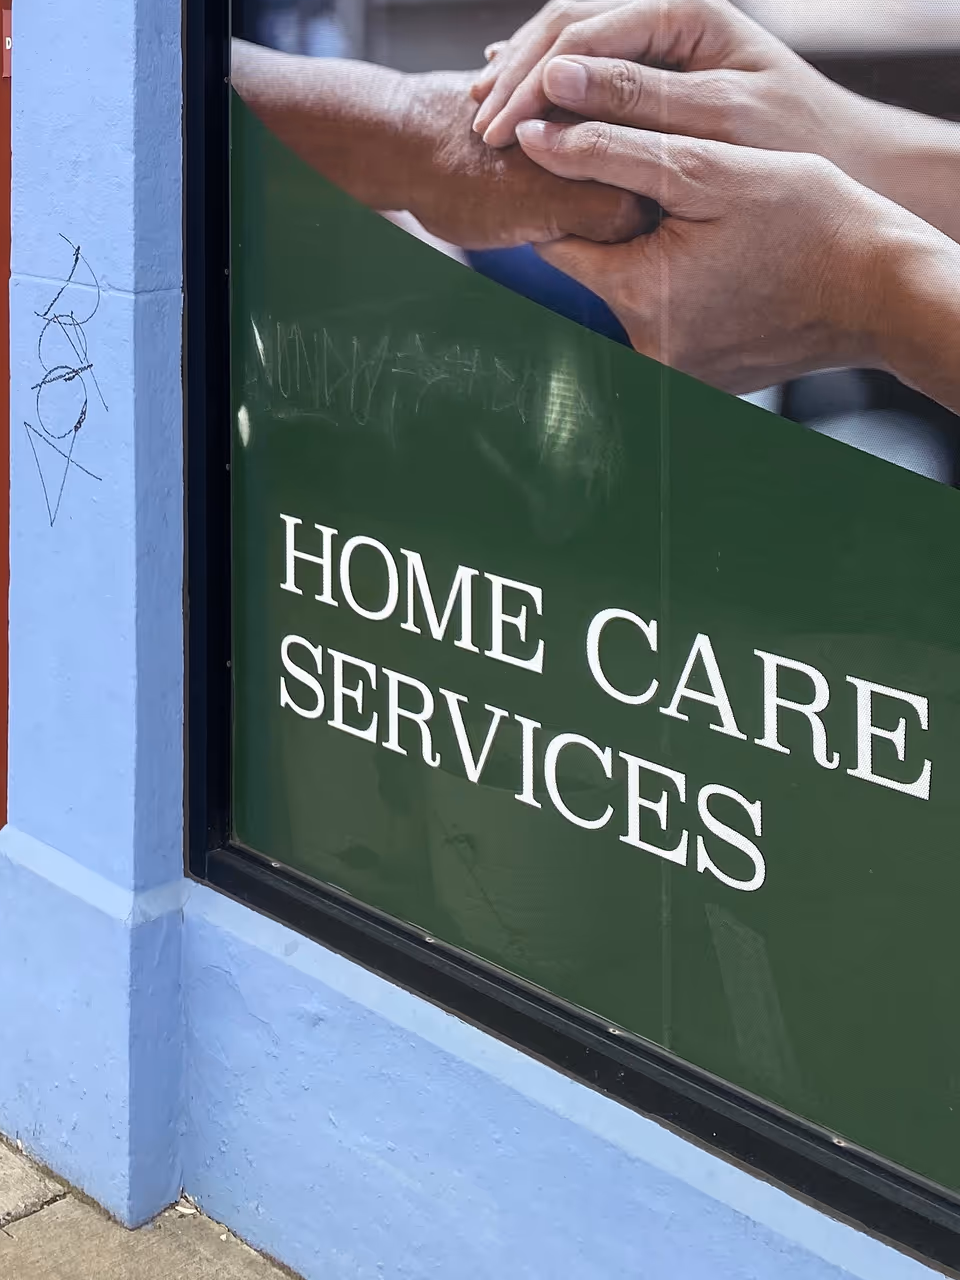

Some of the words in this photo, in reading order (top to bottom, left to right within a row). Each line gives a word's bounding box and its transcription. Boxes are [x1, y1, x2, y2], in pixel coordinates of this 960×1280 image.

[279, 513, 545, 674] HOME
[586, 608, 932, 801] CARE
[280, 634, 766, 892] SERVICES
